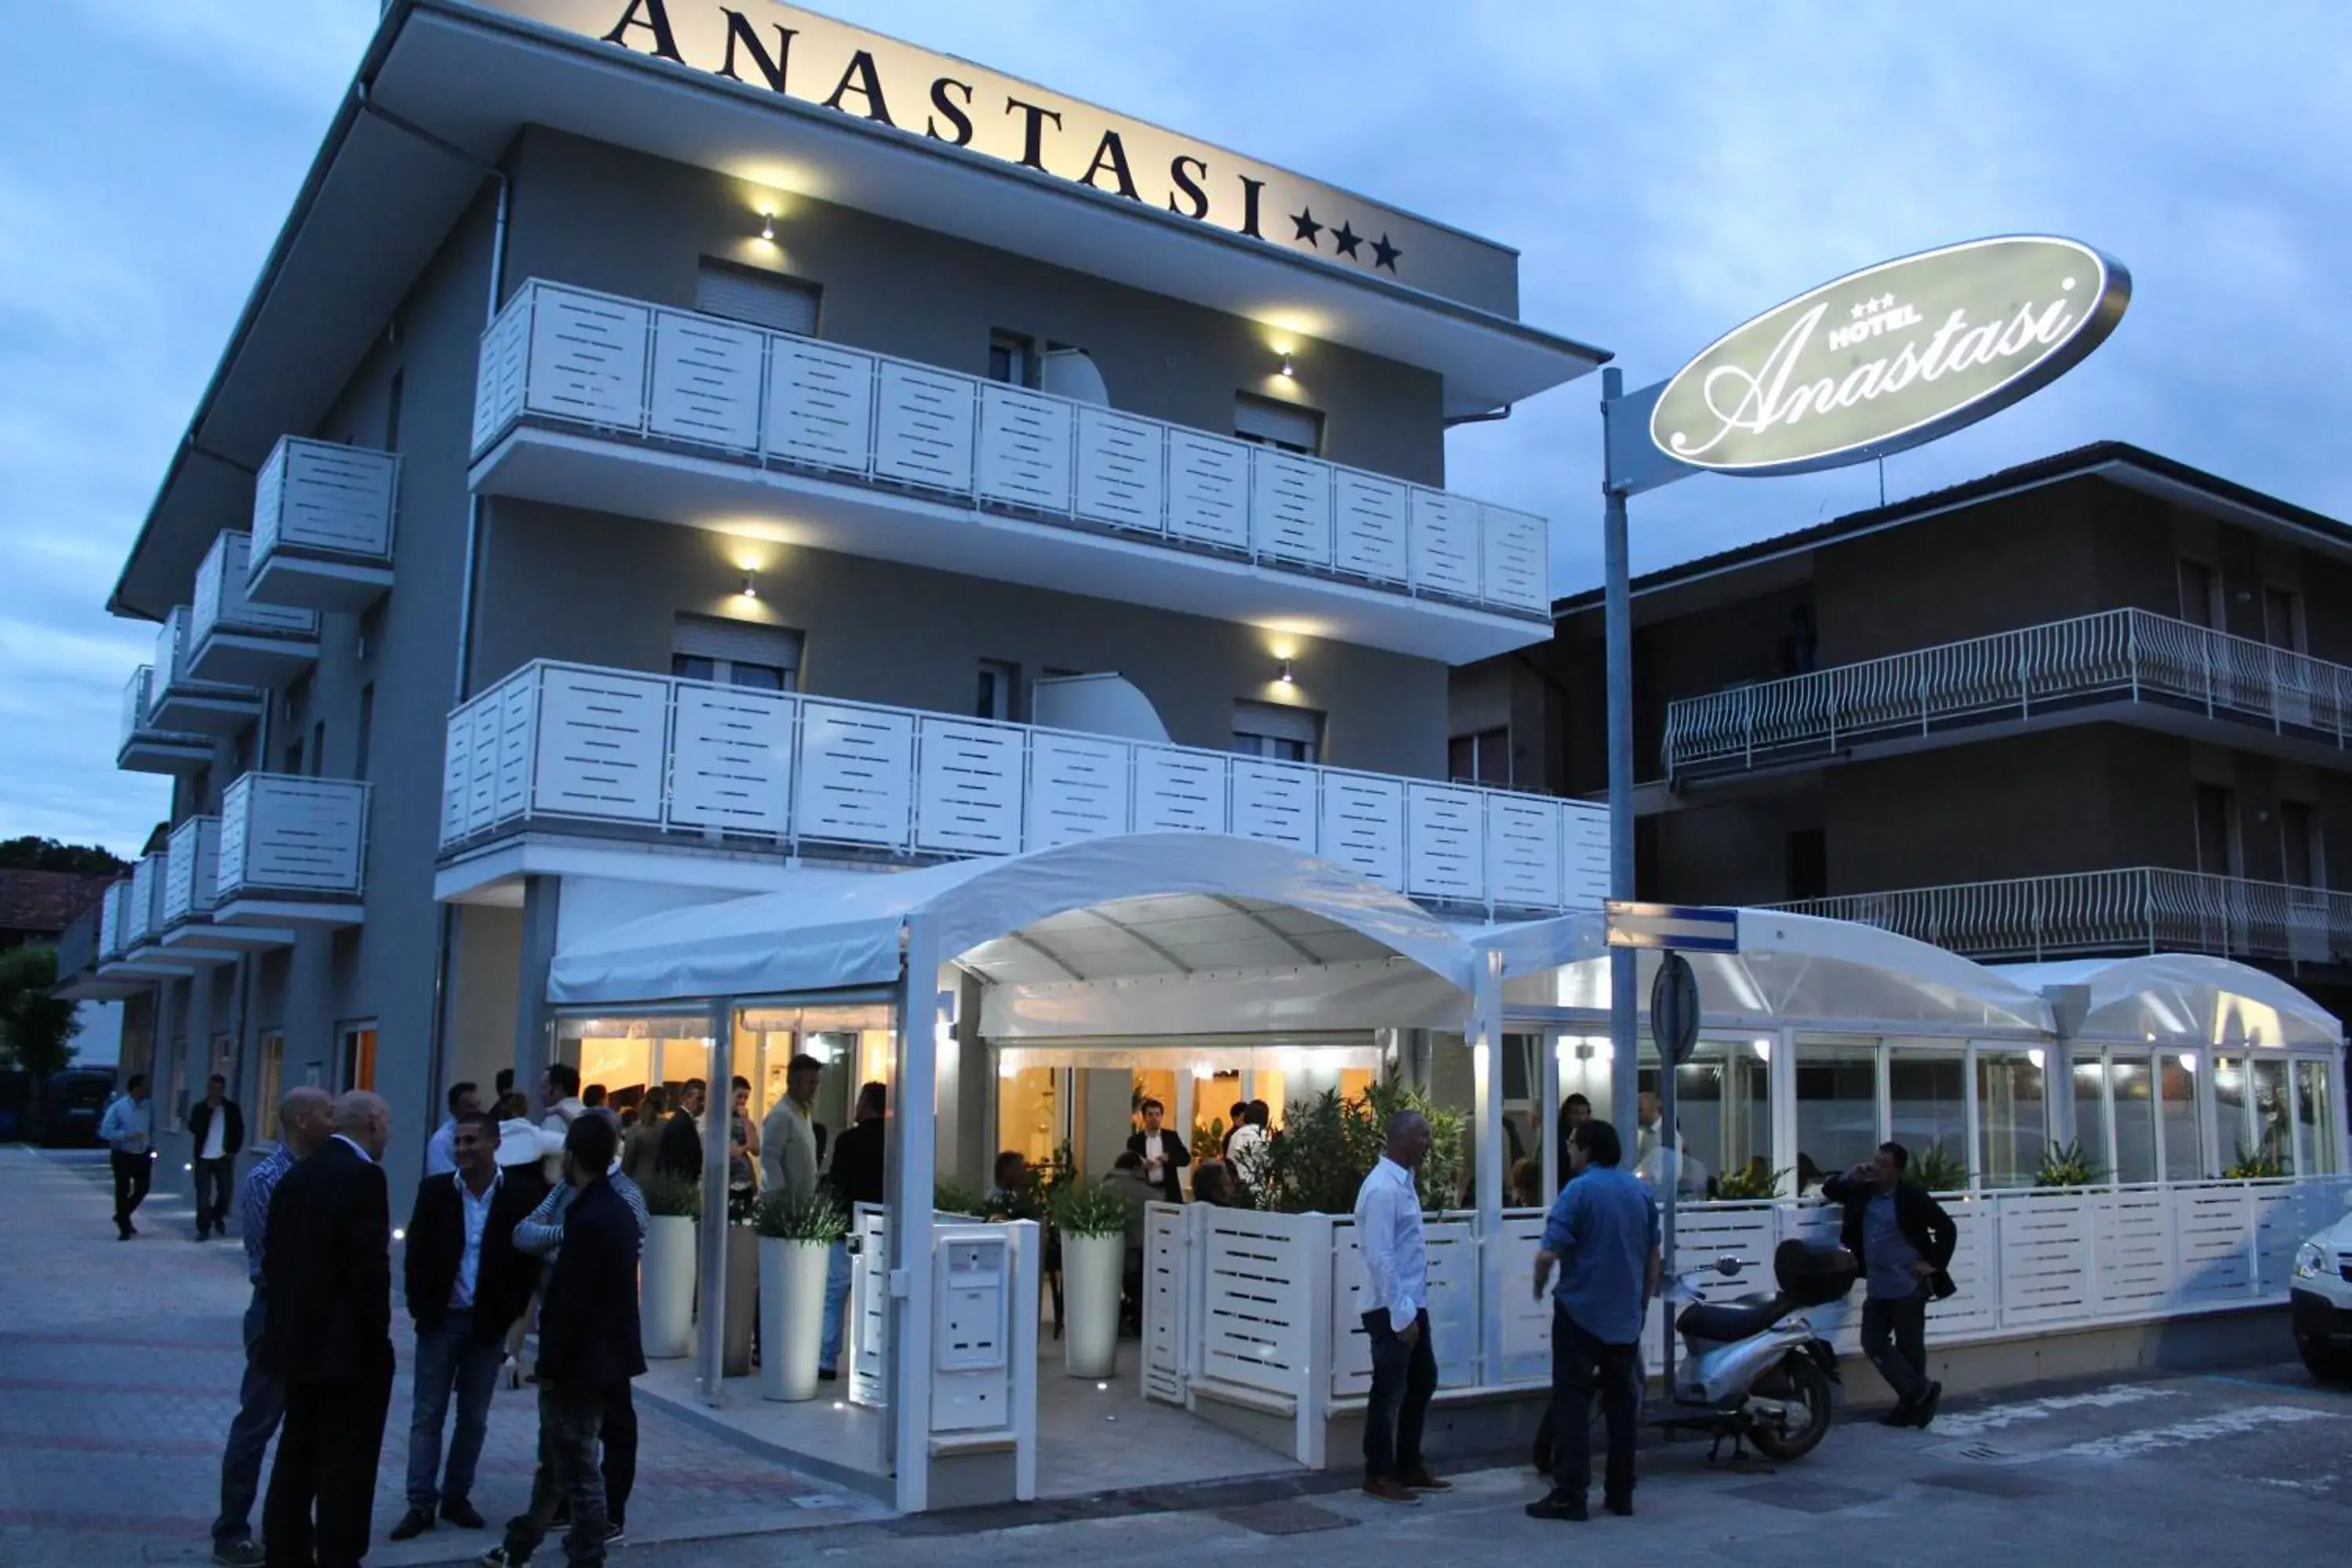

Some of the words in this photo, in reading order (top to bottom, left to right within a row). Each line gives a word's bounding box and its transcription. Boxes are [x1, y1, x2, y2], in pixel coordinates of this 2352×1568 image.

[600, 0, 1265, 240] ANASTASI
[1670, 277, 2077, 456] Anastasi
[1828, 303, 1923, 351] HOTEL
